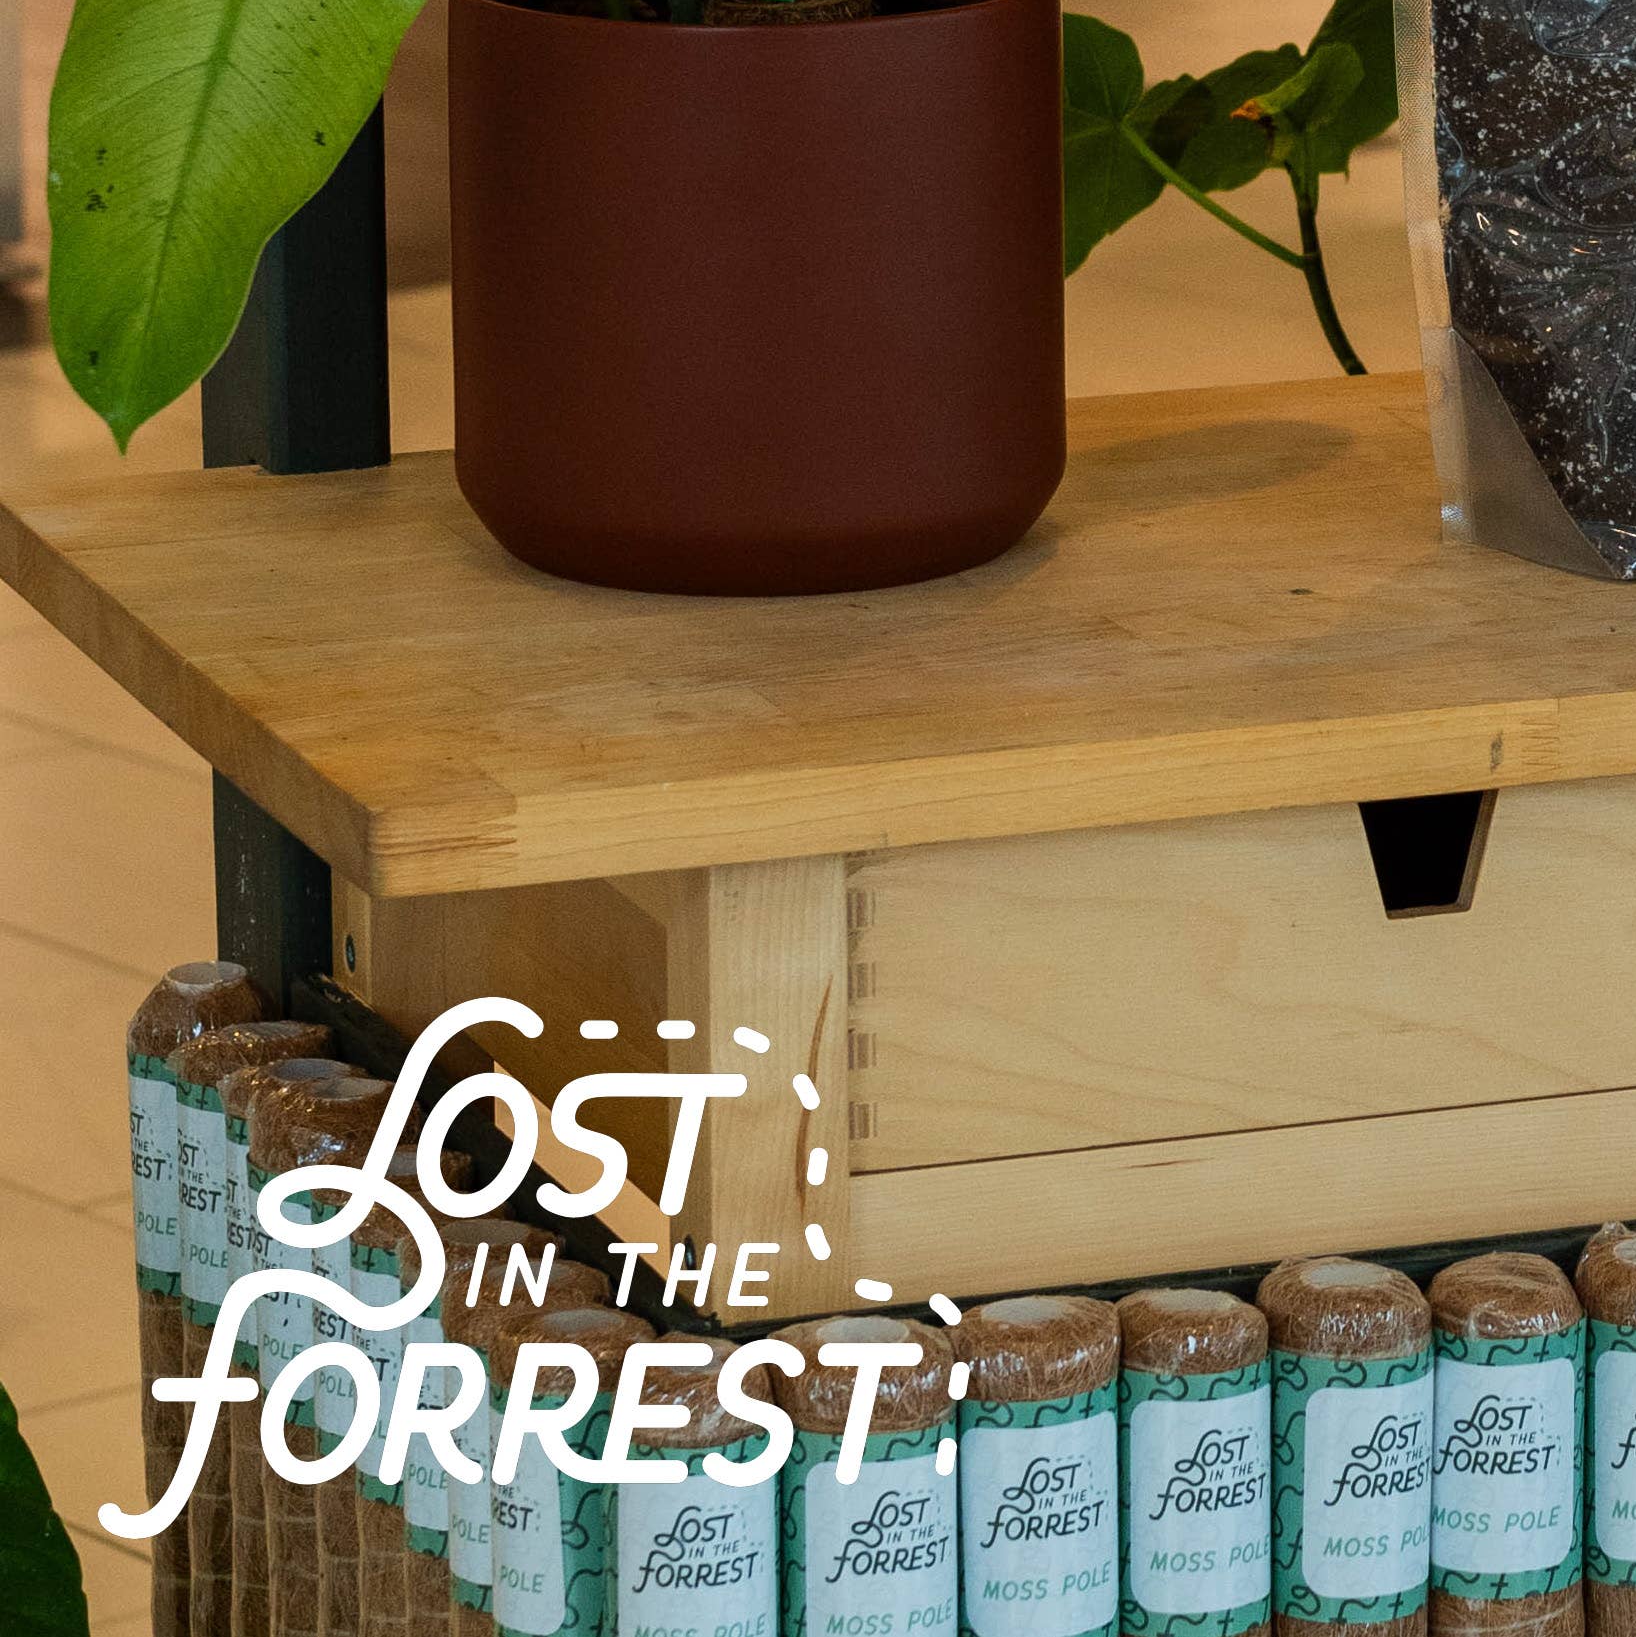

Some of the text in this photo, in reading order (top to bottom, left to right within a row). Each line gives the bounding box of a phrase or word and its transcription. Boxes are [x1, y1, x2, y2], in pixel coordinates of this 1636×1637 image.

[137, 1212, 177, 1235] POLE
[1454, 1394, 1532, 1432] LOST
[1175, 1429, 1250, 1473] LOST
[1352, 1415, 1422, 1459] LOST
[1385, 1447, 1423, 1466] IN THE
[1433, 1435, 1555, 1475] FORREST
[1486, 1431, 1535, 1446] IN THE
[1003, 1457, 1082, 1500] LOST
[1209, 1464, 1254, 1481] IN THE
[851, 1491, 930, 1536] LOST
[1038, 1491, 1087, 1510] IN THE
[1149, 1474, 1267, 1520] FORREST
[654, 1506, 734, 1547] LOST
[886, 1525, 934, 1543] IN THE
[980, 1501, 1104, 1548] FORREST
[1432, 1504, 1561, 1533] MOSS POLE
[688, 1540, 740, 1558] IN THE
[1323, 1521, 1429, 1557] MOSS POL
[632, 1549, 758, 1593] FORREST
[825, 1536, 950, 1583] FORREST
[1150, 1550, 1215, 1572] MOSS
[982, 1561, 1111, 1601] MOSS POLE
[826, 1597, 953, 1636] MOSS POLE
